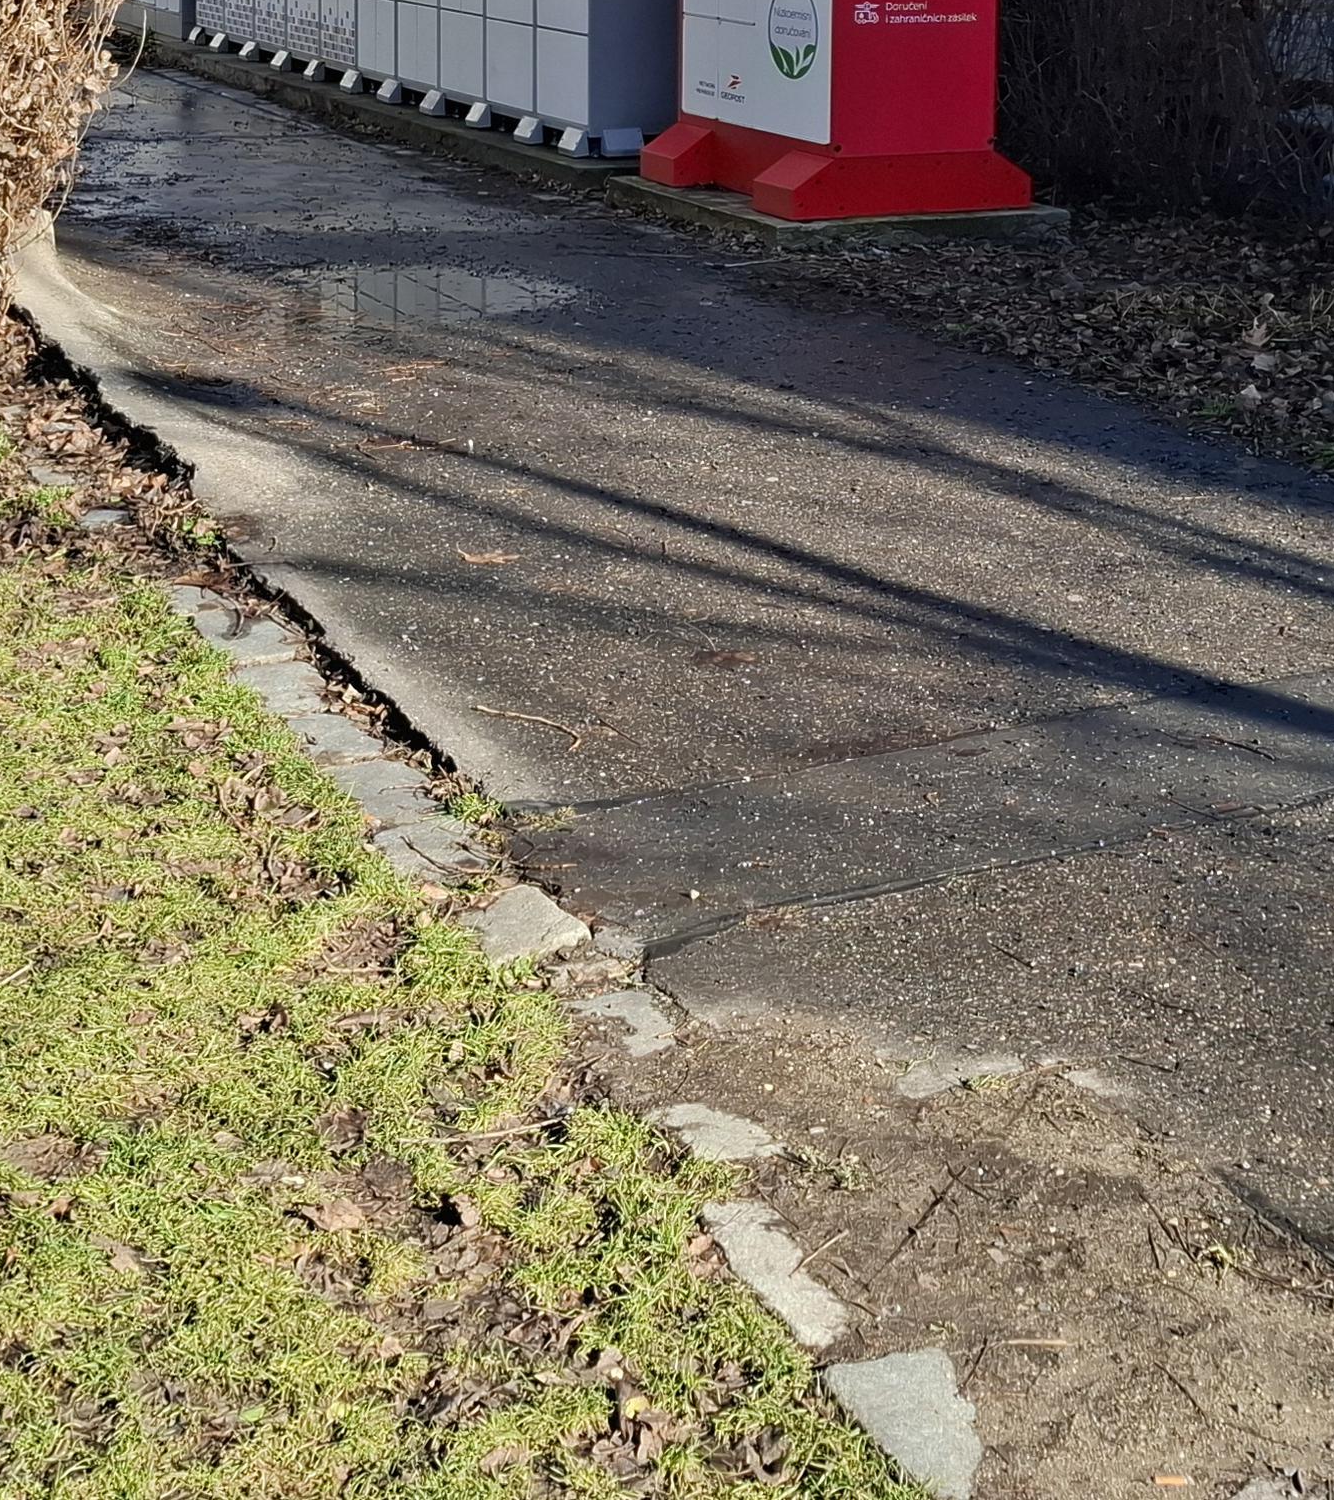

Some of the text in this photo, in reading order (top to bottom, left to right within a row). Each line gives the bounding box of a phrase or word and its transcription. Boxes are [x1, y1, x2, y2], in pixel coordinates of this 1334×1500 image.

[885, 1, 928, 11] Doručení
[889, 12, 947, 24] zahraničních
[947, 12, 978, 22] zásilek
